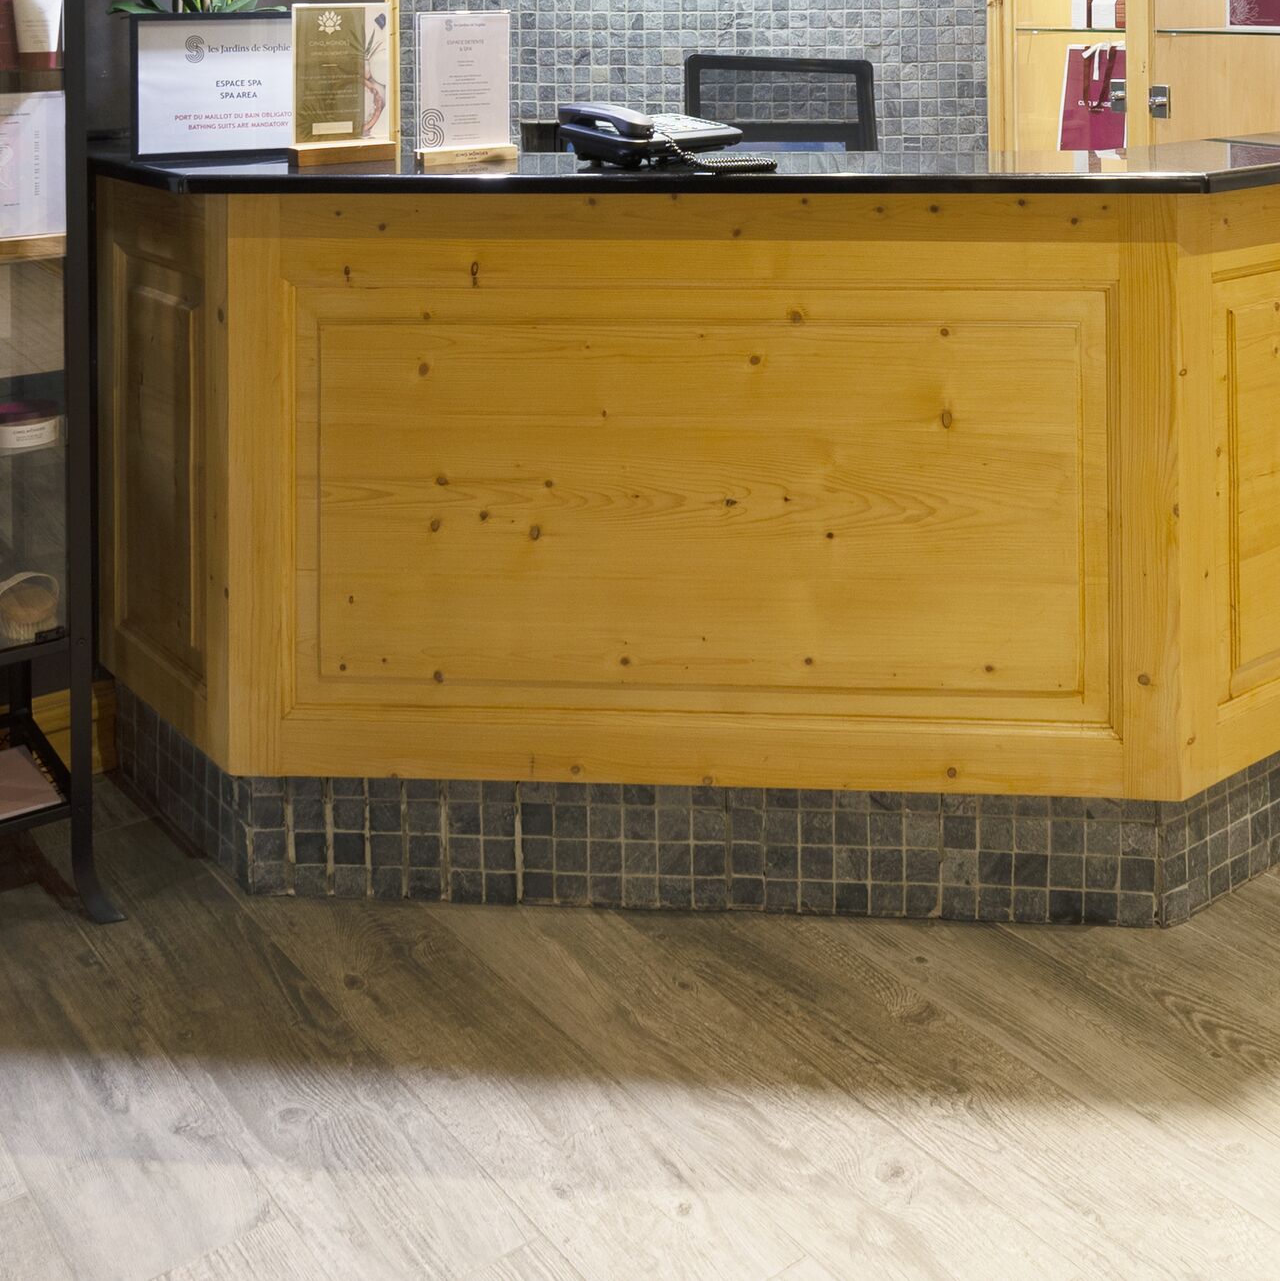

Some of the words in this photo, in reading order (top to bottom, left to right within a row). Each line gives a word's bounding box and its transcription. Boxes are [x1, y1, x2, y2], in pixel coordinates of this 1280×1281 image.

[208, 45, 219, 53] les
[221, 44, 249, 54] Jardins
[251, 44, 261, 52] de
[263, 43, 290, 53] Sophie
